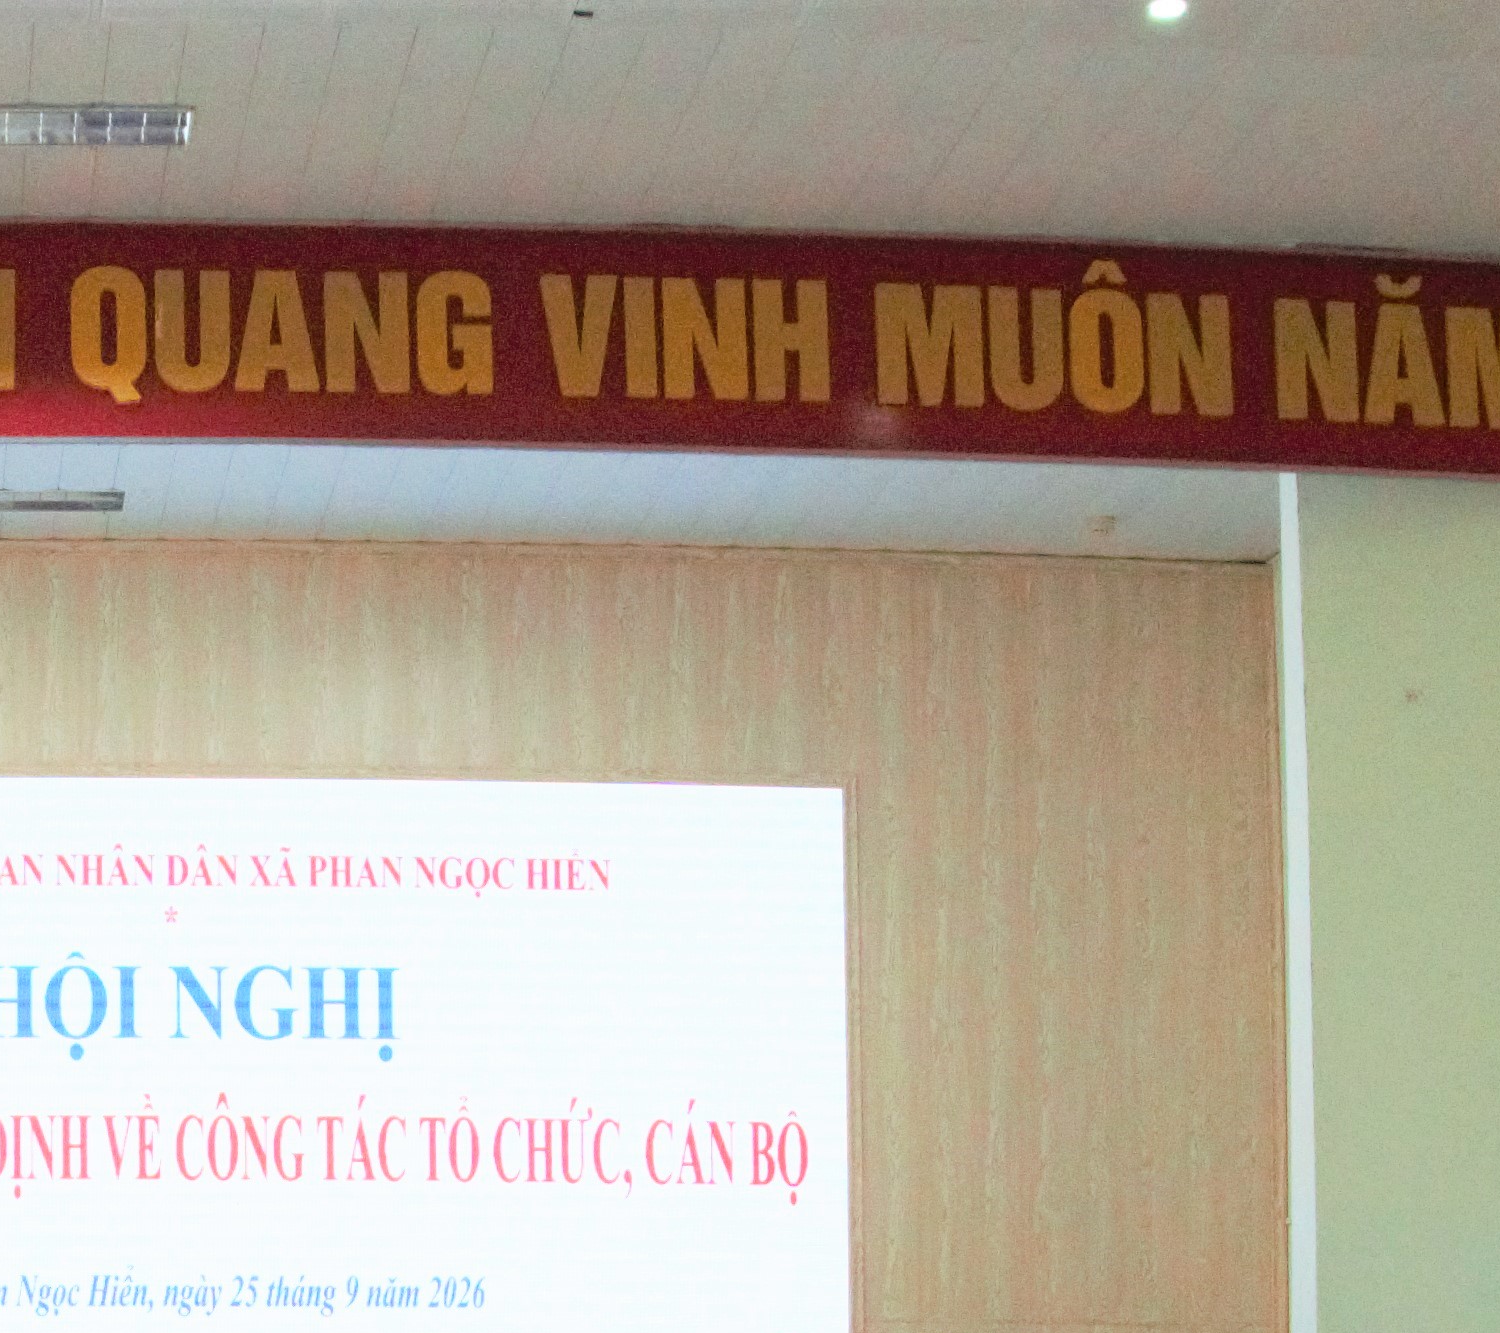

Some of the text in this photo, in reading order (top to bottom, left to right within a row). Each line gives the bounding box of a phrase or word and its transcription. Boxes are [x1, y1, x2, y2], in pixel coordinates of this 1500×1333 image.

[71, 266, 493, 404] QUANG
[540, 271, 830, 402] VINH
[874, 260, 1234, 416] MUÔN
[57, 844, 153, 886] NHÂN
[168, 844, 237, 886] DÂN
[251, 847, 296, 887] XÃ
[310, 856, 401, 887] PHAN
[415, 857, 514, 897] NGỌC
[170, 964, 398, 1062] NGHỊ
[104, 1094, 161, 1180] VỀ
[176, 1092, 303, 1181] CÔNG
[317, 1094, 406, 1182] TÁC
[419, 1096, 480, 1183] TỔ
[493, 1097, 632, 1199] CHỨC,
[645, 1099, 734, 1185] CÁN
[751, 1112, 808, 1205] BỘ
[16, 1274, 80, 1317] Ngọc
[88, 1266, 154, 1311] Hiển,
[162, 1275, 223, 1316] ngày
[229, 1274, 259, 1308] 25
[265, 1275, 336, 1315] tháng
[346, 1276, 360, 1307] 9
[366, 1278, 420, 1308] năm
[428, 1276, 485, 1309] 2026
